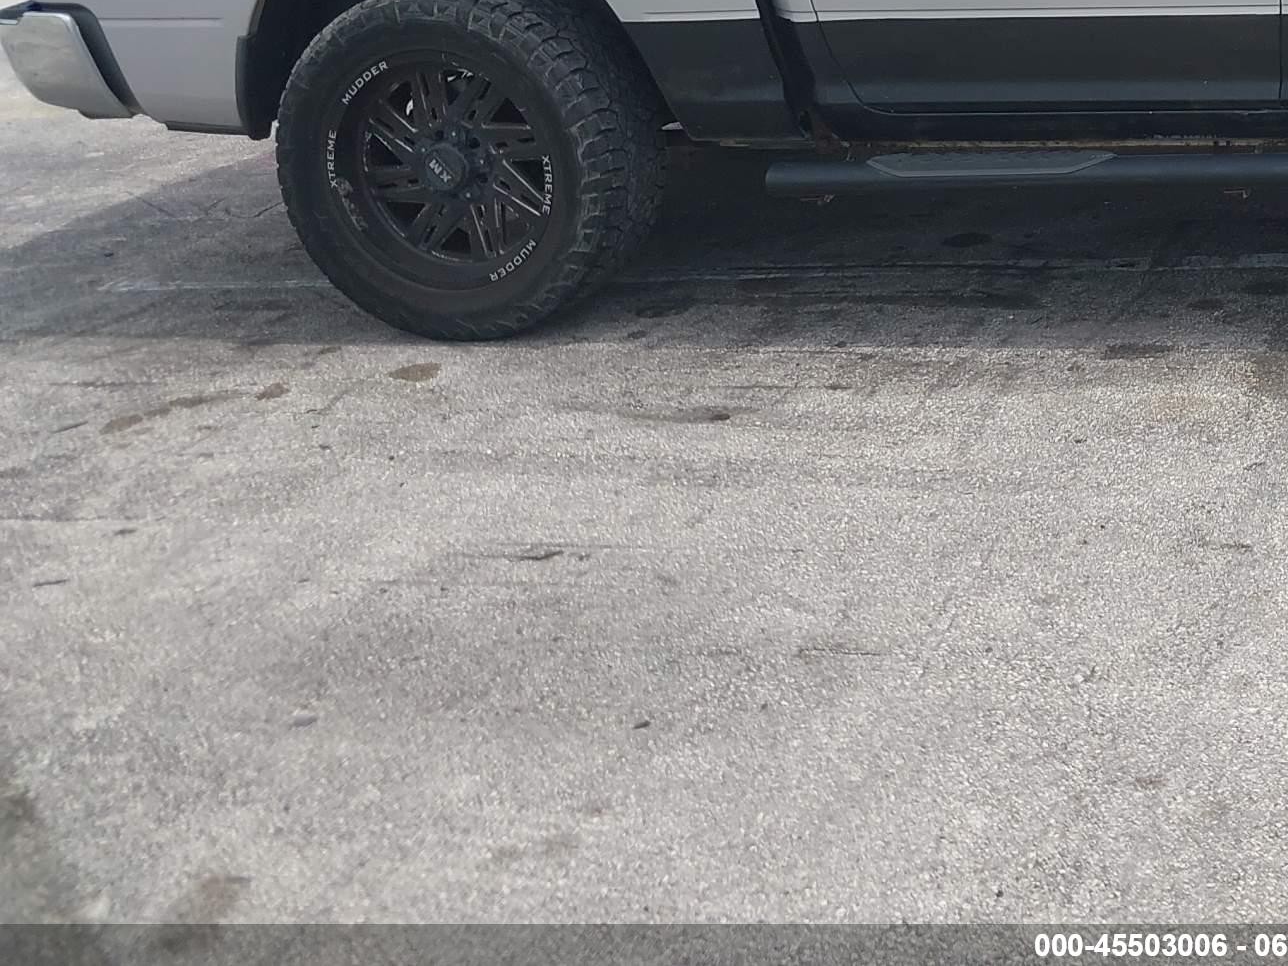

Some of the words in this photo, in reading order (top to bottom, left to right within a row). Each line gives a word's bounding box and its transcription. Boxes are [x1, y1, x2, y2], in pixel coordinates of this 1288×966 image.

[327, 129, 337, 188] XTREME
[341, 60, 388, 105] MUDDER
[541, 155, 555, 215] XTREME
[489, 239, 537, 282] MUDDER
